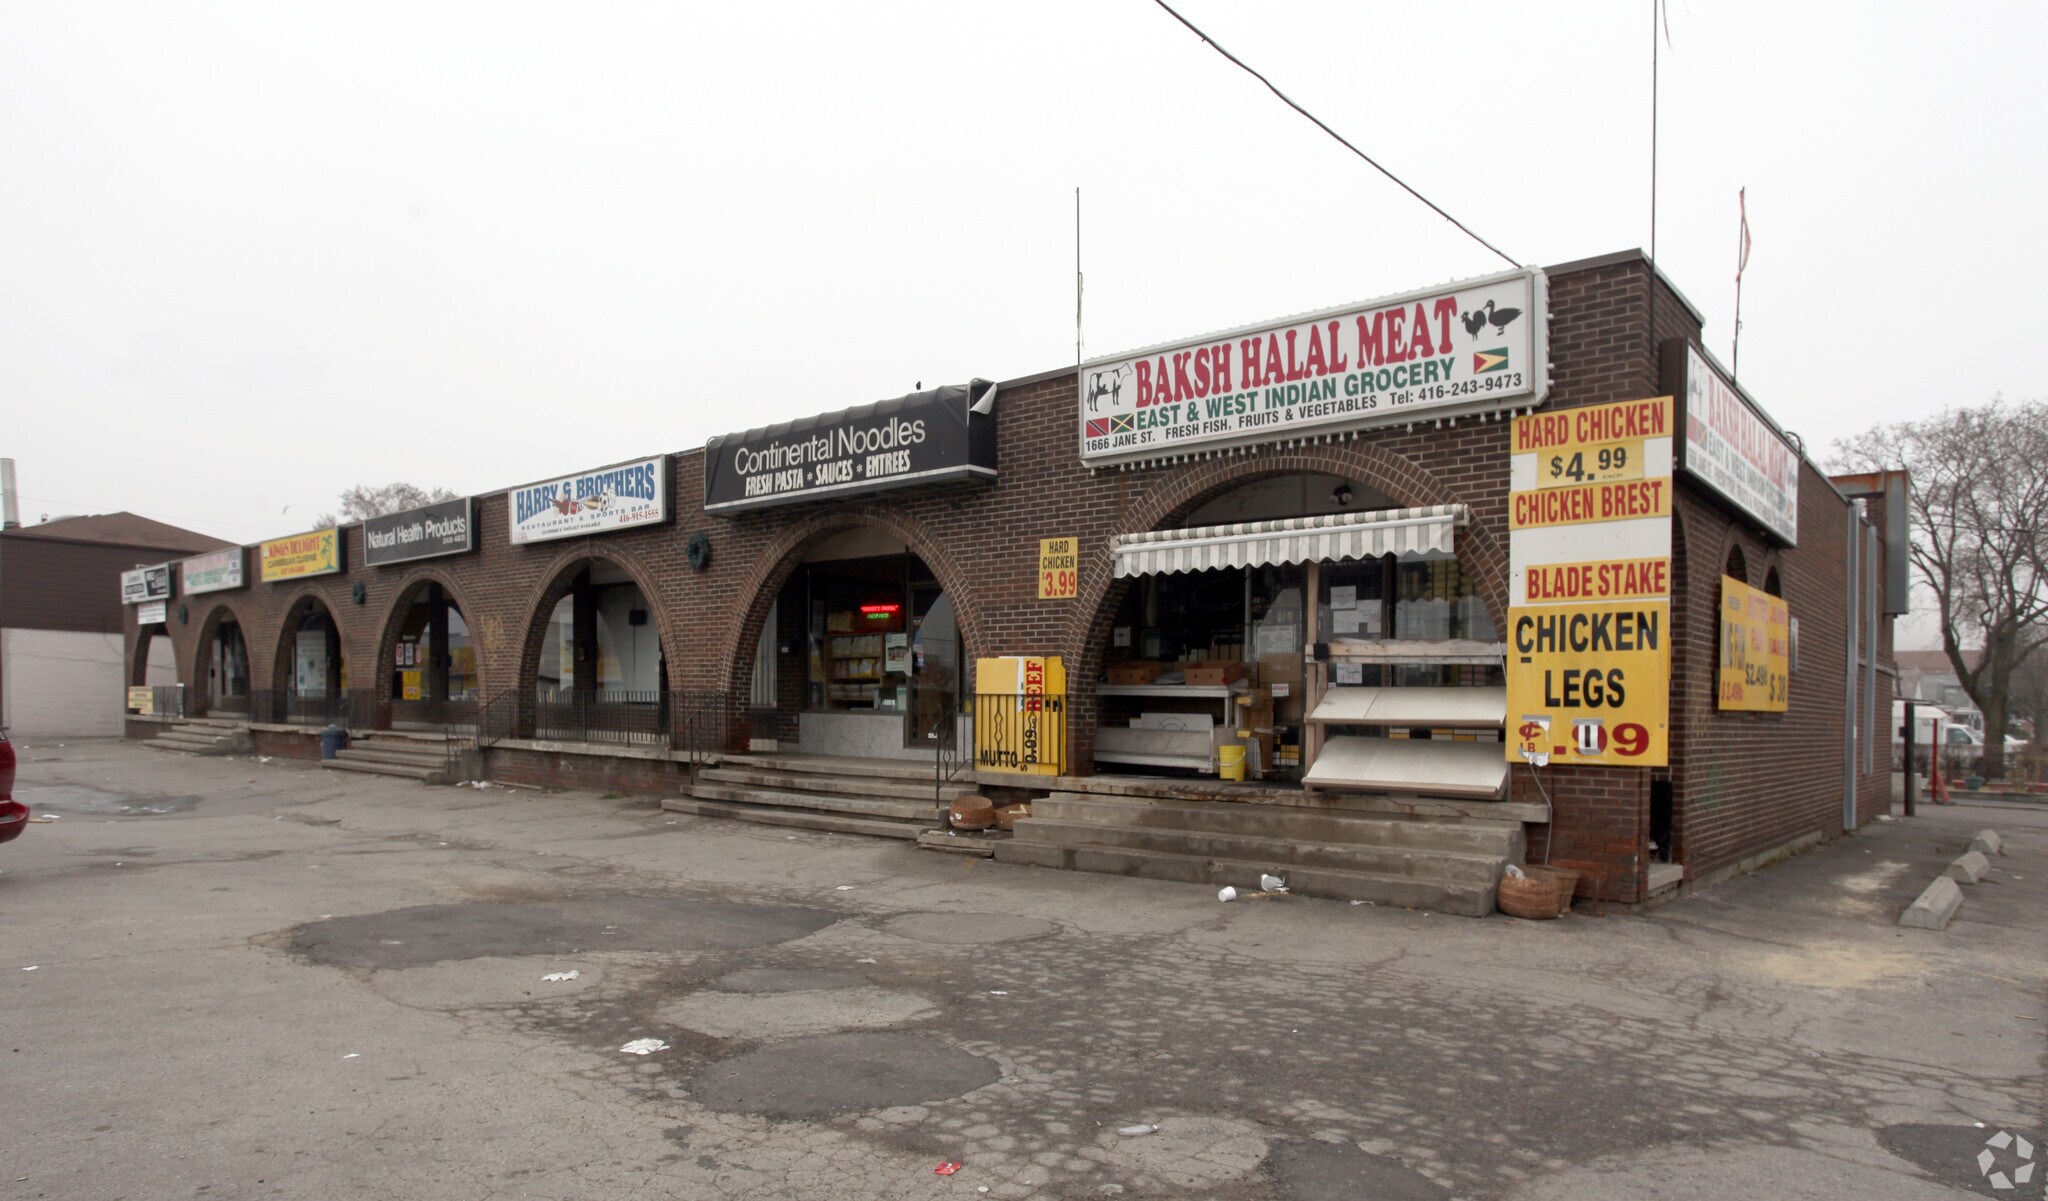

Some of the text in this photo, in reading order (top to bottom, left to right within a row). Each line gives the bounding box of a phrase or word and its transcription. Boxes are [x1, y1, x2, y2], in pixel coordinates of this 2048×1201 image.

[1135, 296, 1457, 408] BAKSH HALAL MEAT
[1086, 372, 1522, 451] 1666 JANE ST. FRESH FISH, FRUITS & VEGETABLES Tel: 416-243-9473
[1137, 357, 1455, 430] EAST & WEST INDIAN GROCERY
[735, 417, 926, 475] Continental Noodles
[1518, 402, 1664, 450] HARD CHICKEN
[516, 484, 557, 525] HARRY
[576, 463, 656, 501] BROTHERS
[745, 450, 911, 497] FRESH PASTA SAUCES ENTREES
[521, 517, 574, 531] RESTAURANT
[591, 508, 625, 520] SPORTS
[631, 504, 650, 512] BAR
[1515, 481, 1662, 526] CHICKEN BREST
[368, 528, 396, 549] Natural
[397, 523, 423, 545] Health
[425, 516, 466, 539] Products
[1049, 540, 1069, 554] HARD
[1042, 555, 1075, 569] CHICKEN
[1528, 561, 1665, 600] BLADE STAKE
[1516, 611, 1658, 654] CHICKEN
[1026, 660, 1043, 712] BEEF
[1545, 668, 1626, 708] LEGS
